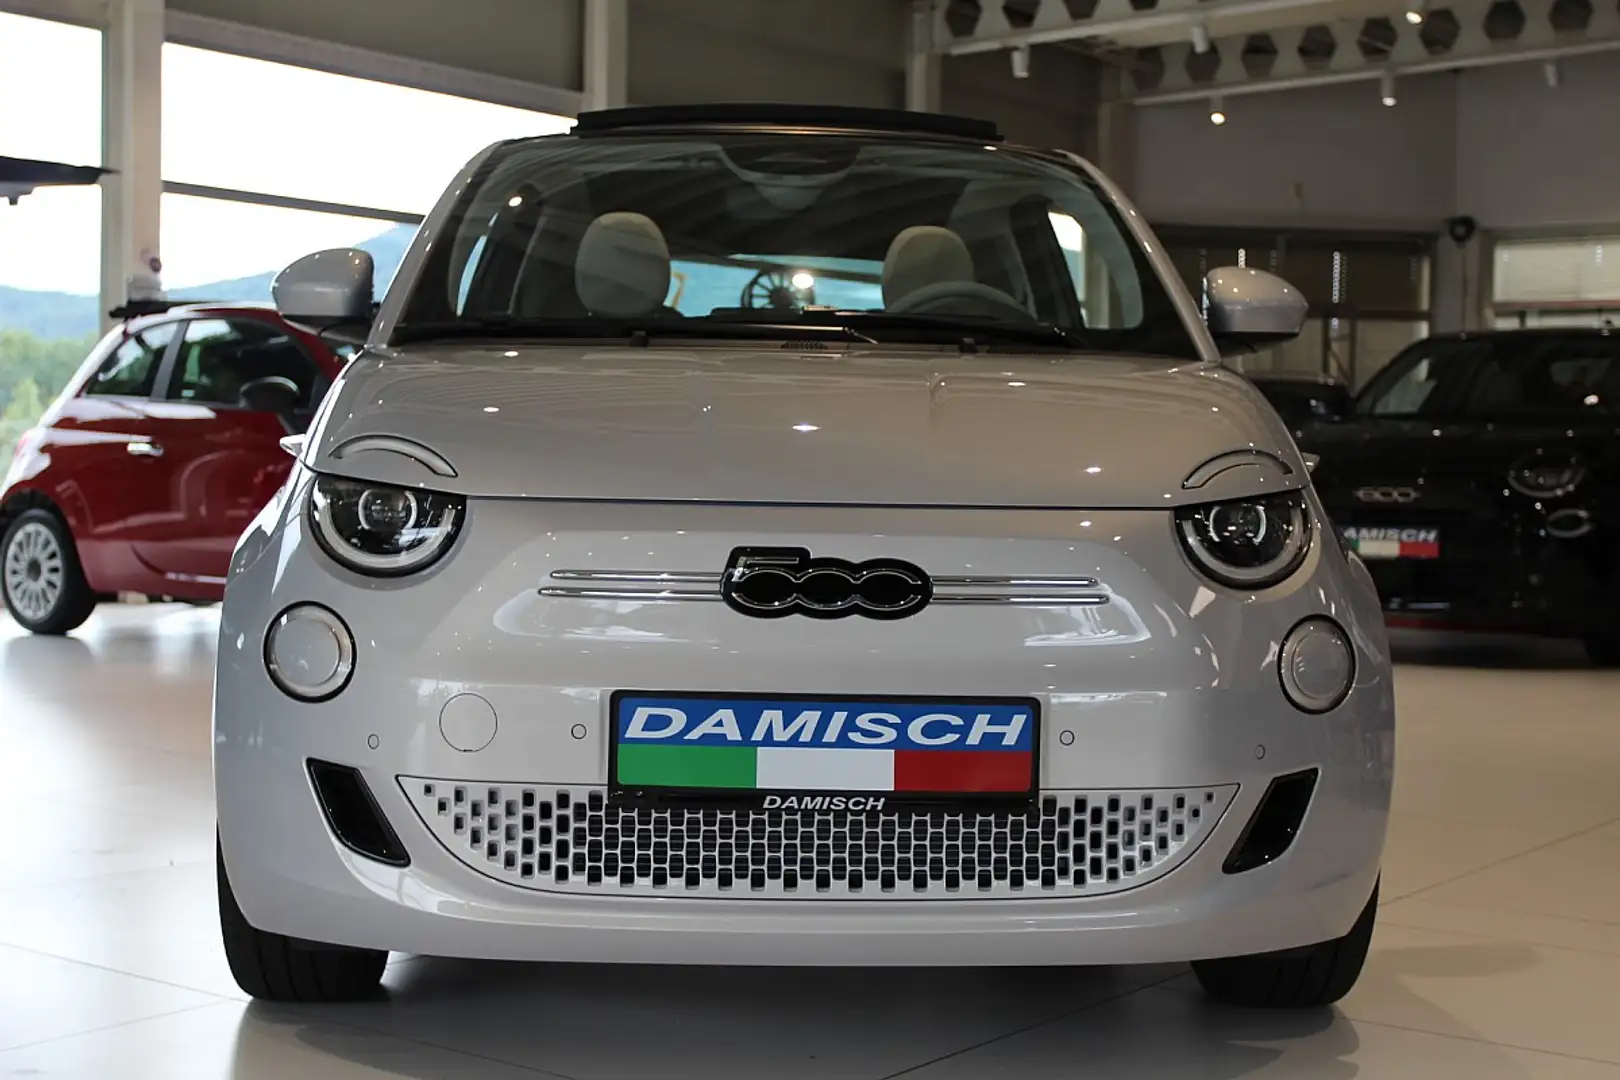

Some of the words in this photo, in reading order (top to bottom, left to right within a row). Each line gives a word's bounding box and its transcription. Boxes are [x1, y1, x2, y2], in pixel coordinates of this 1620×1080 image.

[1341, 526, 1438, 544] AMISCH
[722, 547, 932, 619] 500
[624, 706, 1028, 746] DAMISCH
[762, 795, 886, 811] DAMISCH
